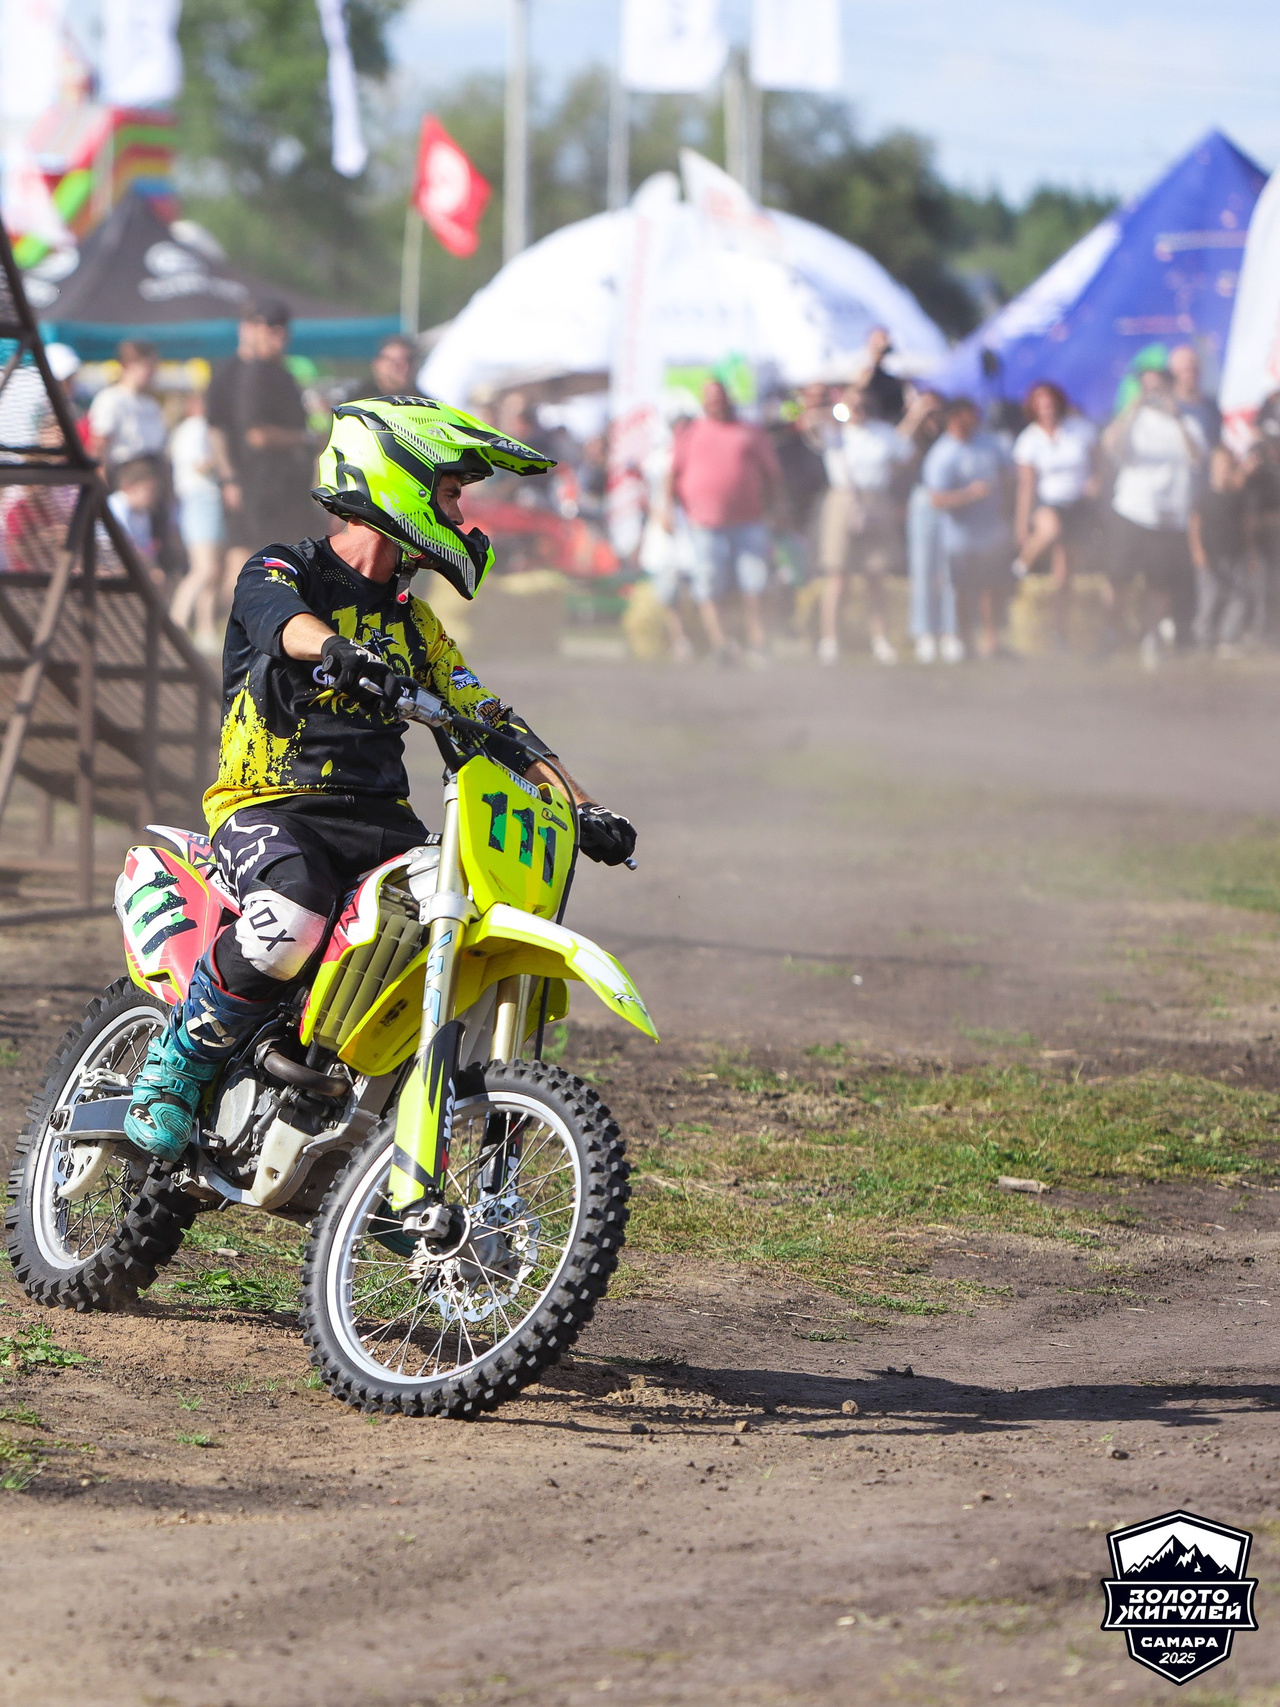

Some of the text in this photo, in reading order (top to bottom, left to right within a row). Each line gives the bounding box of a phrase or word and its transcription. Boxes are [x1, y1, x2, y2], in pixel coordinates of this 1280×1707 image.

[481, 791, 557, 889] 111
[124, 870, 198, 960] 111
[248, 906, 297, 952] OX
